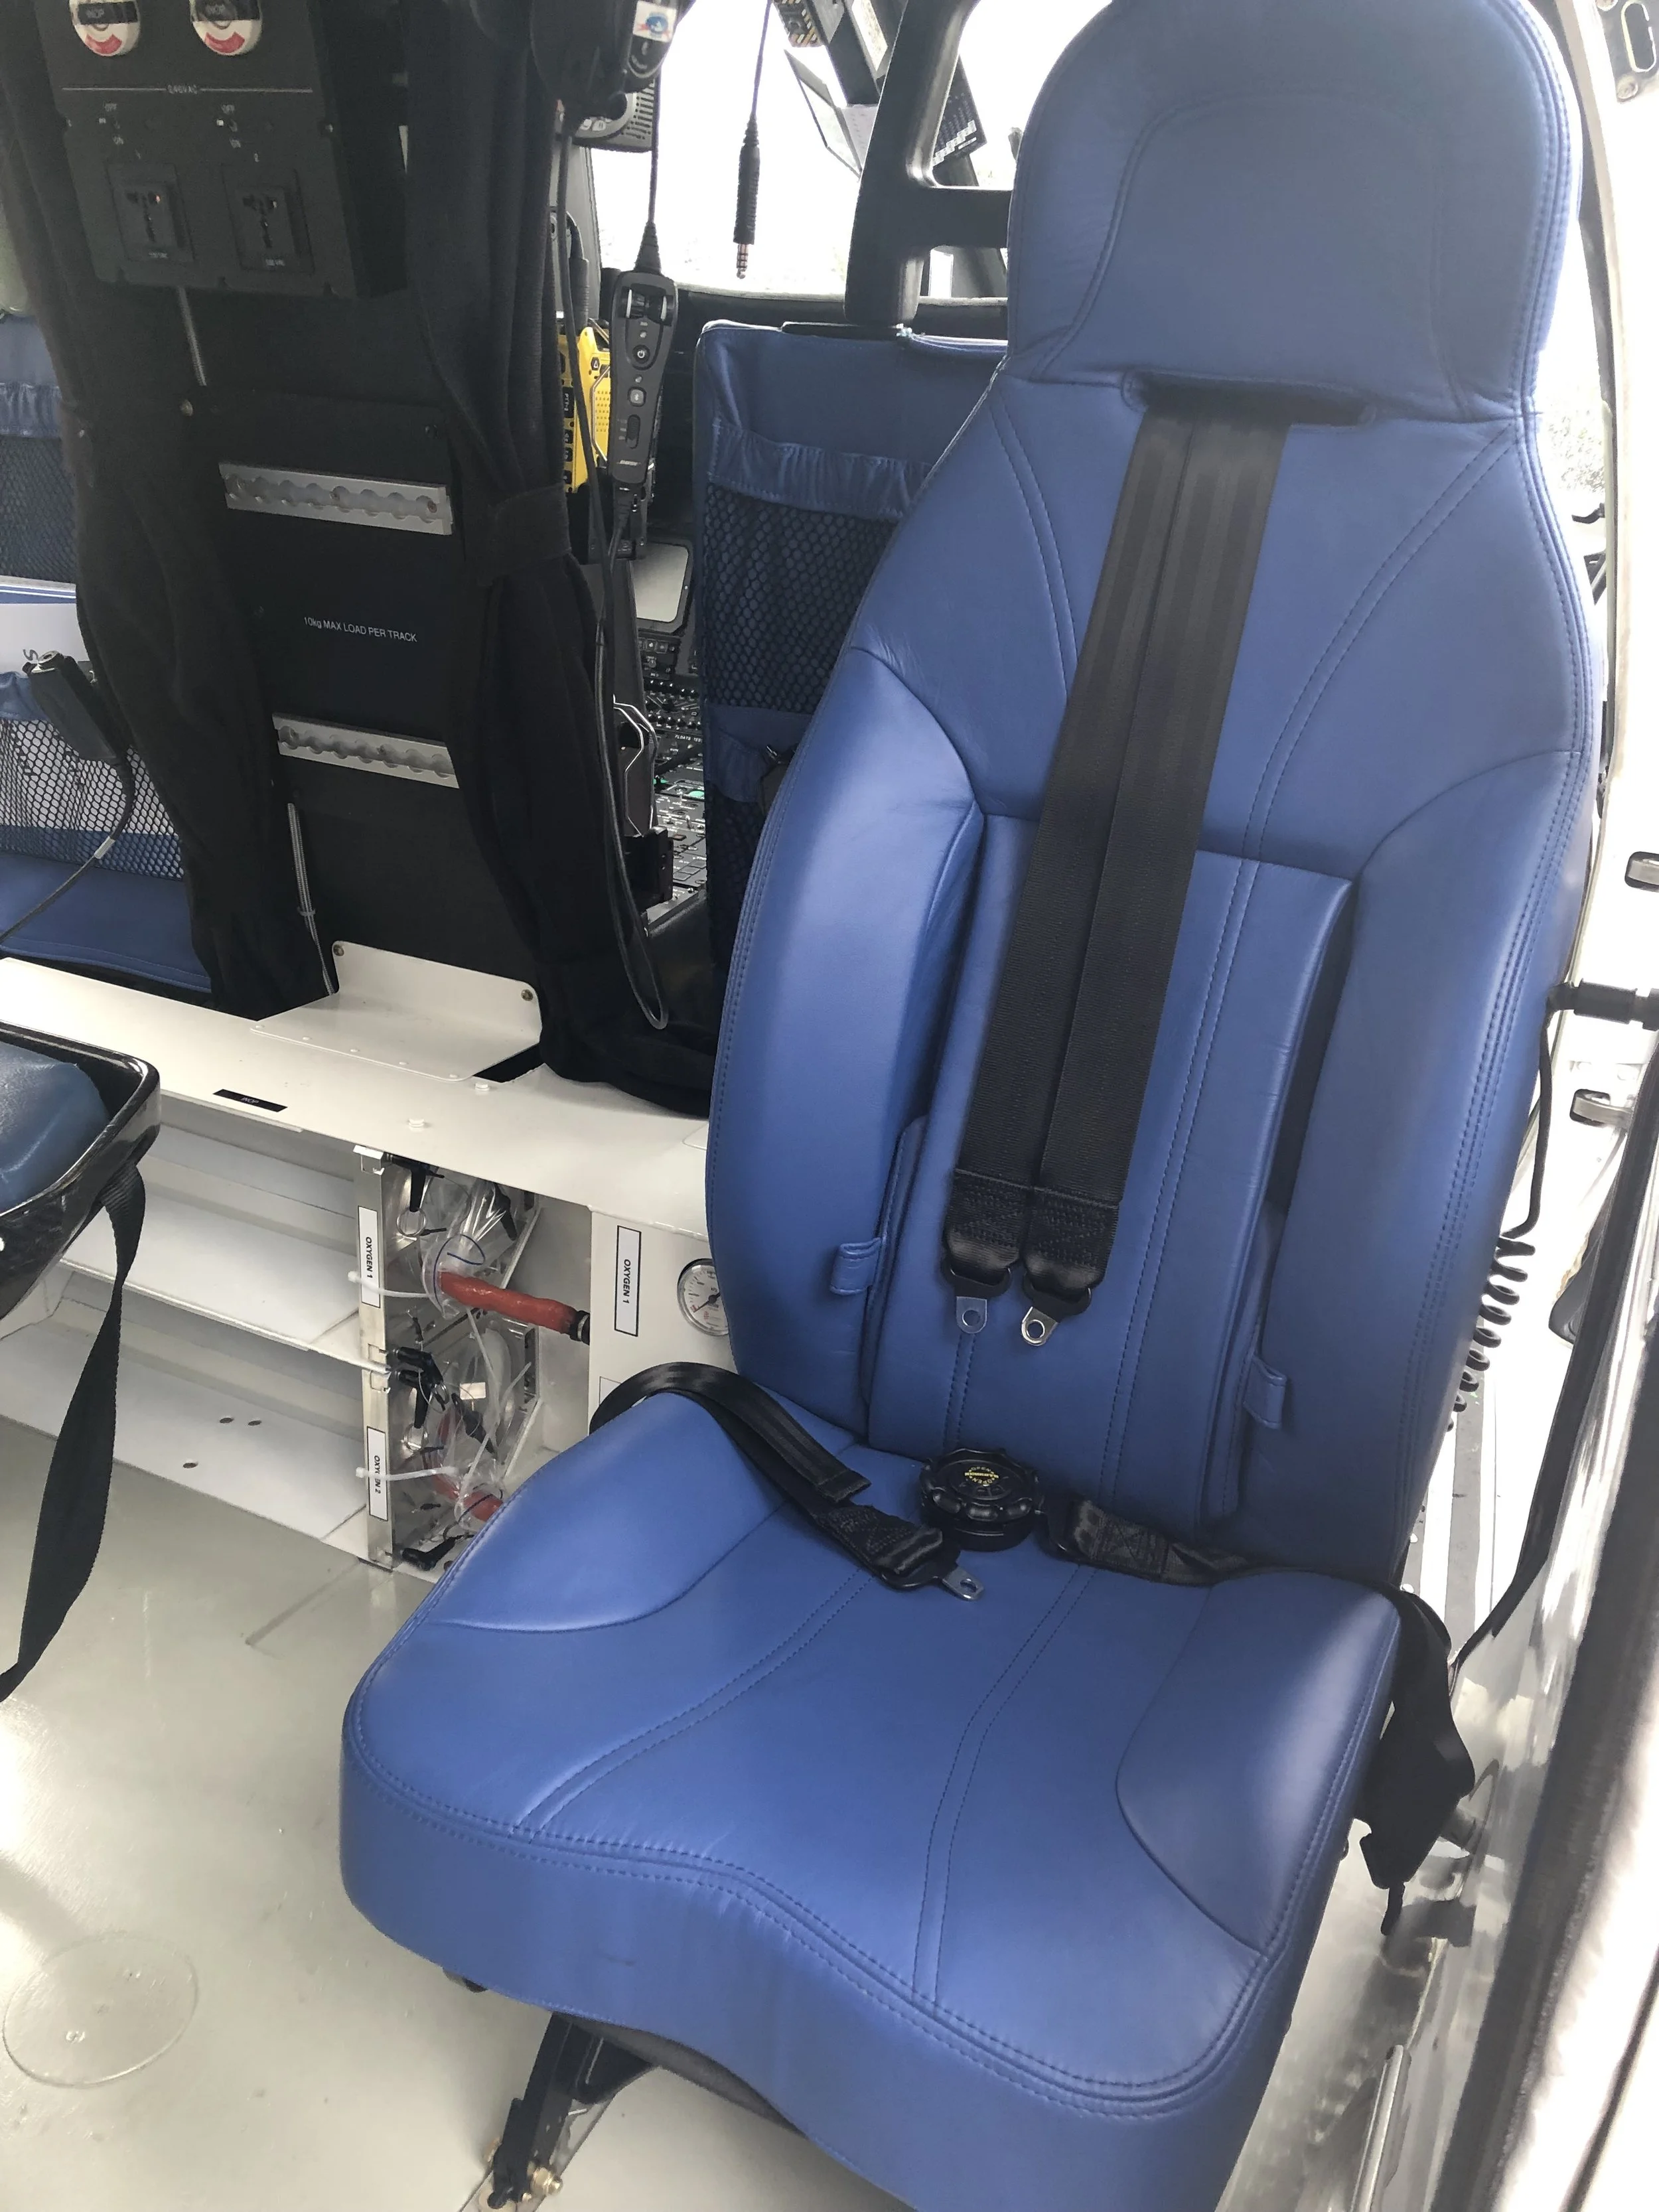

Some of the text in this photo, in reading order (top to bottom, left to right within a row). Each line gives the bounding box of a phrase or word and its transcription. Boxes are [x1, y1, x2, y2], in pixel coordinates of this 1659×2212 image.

[304, 617, 417, 642] 10kg MAX LOAD PER TRACK
[622, 1259, 631, 1297] OXYGEN
